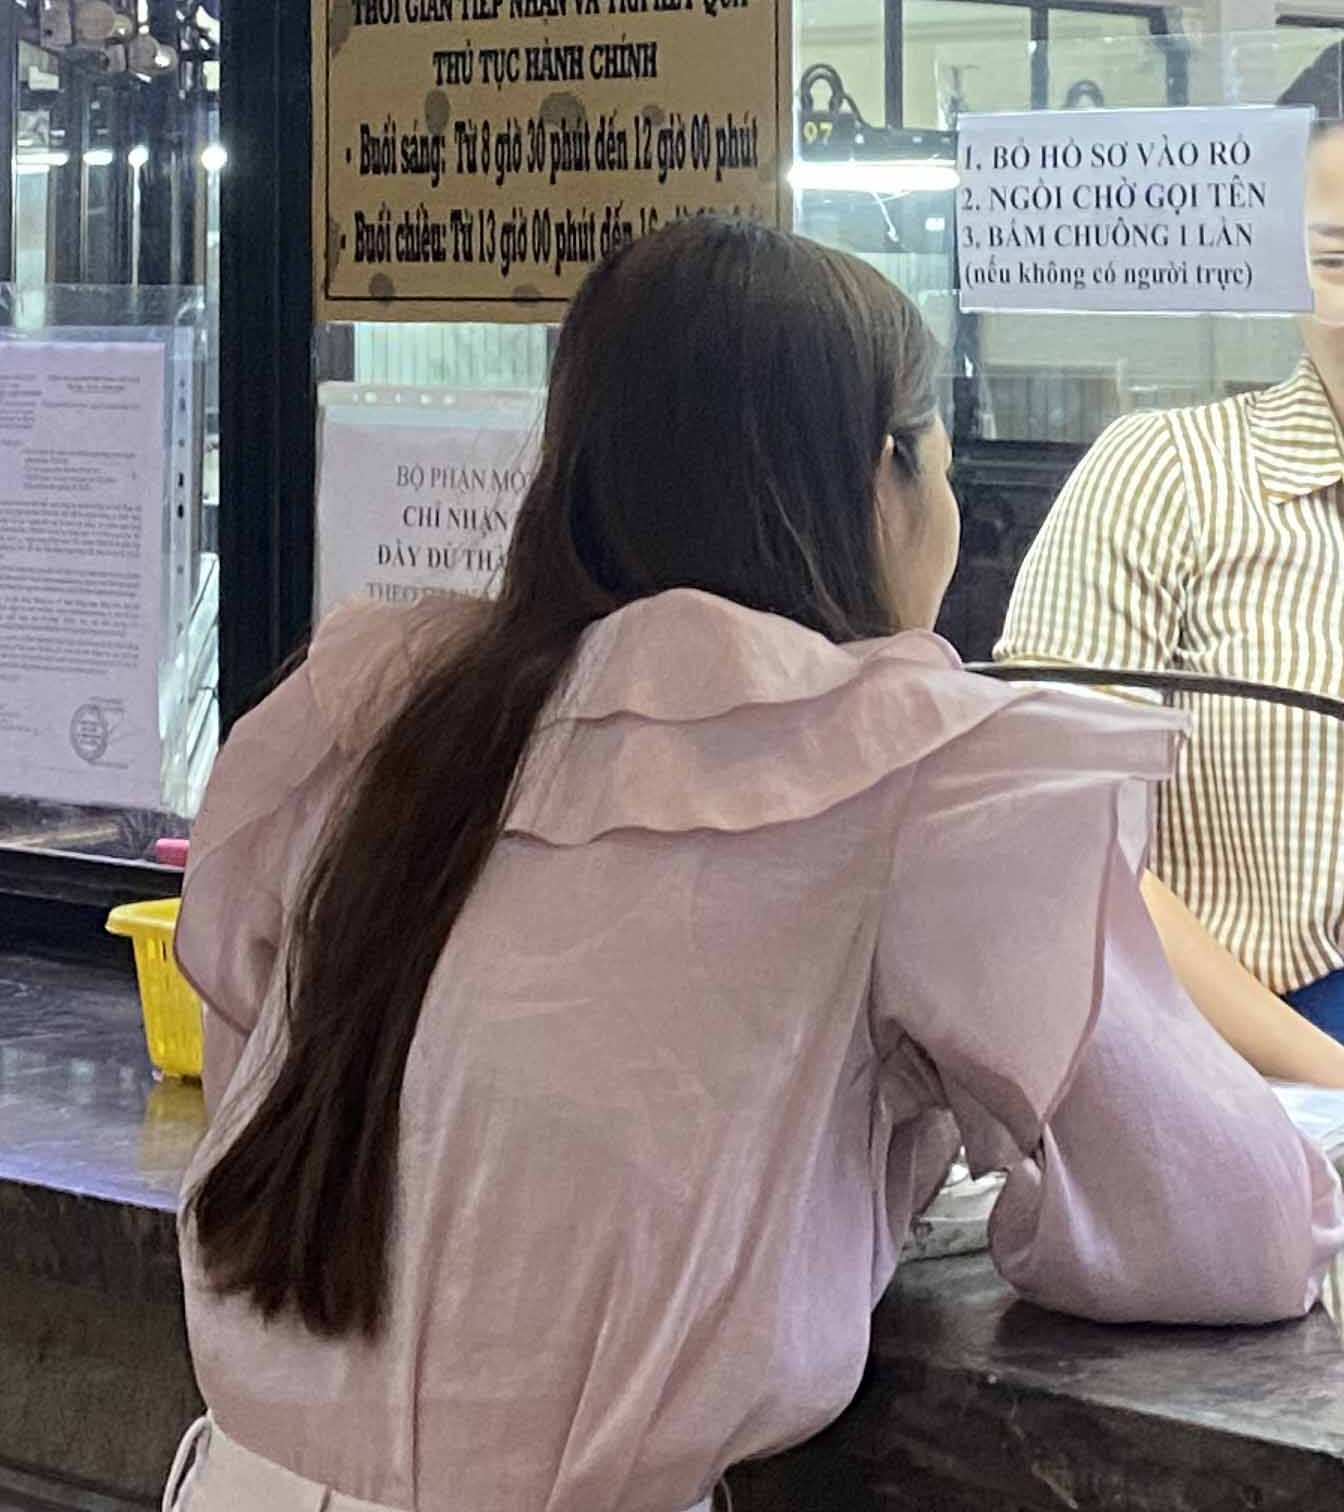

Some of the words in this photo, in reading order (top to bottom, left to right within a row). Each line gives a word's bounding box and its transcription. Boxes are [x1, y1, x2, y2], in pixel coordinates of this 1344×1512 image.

[432, 38, 474, 86] THỦ
[479, 48, 520, 92] TỤC
[525, 37, 584, 82] HÀNH
[590, 32, 658, 80] CHÍNH
[359, 113, 397, 175] Buổi
[401, 120, 446, 188] sáng:
[454, 118, 478, 174] Từ
[481, 120, 491, 174] 8
[494, 117, 523, 186] giờ
[526, 116, 546, 173] 30
[550, 116, 590, 184] phút
[634, 114, 653, 170] 12
[657, 111, 686, 184] giờ
[690, 113, 711, 170] 00
[715, 109, 758, 183] phút
[964, 144, 982, 171] 1.
[1090, 140, 1129, 169] SƠ
[1136, 133, 1199, 167] VÀO
[961, 187, 981, 211] 2.
[1072, 176, 1137, 210] CHỜ
[1145, 182, 1198, 216] GỌI
[1207, 174, 1266, 208] TÊN
[354, 201, 392, 263] Buổi
[395, 202, 446, 262] chiều:
[450, 207, 475, 263] Từ
[478, 208, 496, 263] 13
[500, 206, 528, 278] giờ
[531, 207, 552, 264] 00
[554, 205, 596, 276] phút
[961, 225, 981, 249] 3.
[1054, 216, 1169, 248] CHUÔNG
[1180, 224, 1187, 247] 1
[965, 254, 1011, 290] (nếu
[1019, 260, 1086, 289] không
[1092, 260, 1116, 285] có
[1124, 260, 1188, 290] người
[1196, 261, 1253, 291] trực)
